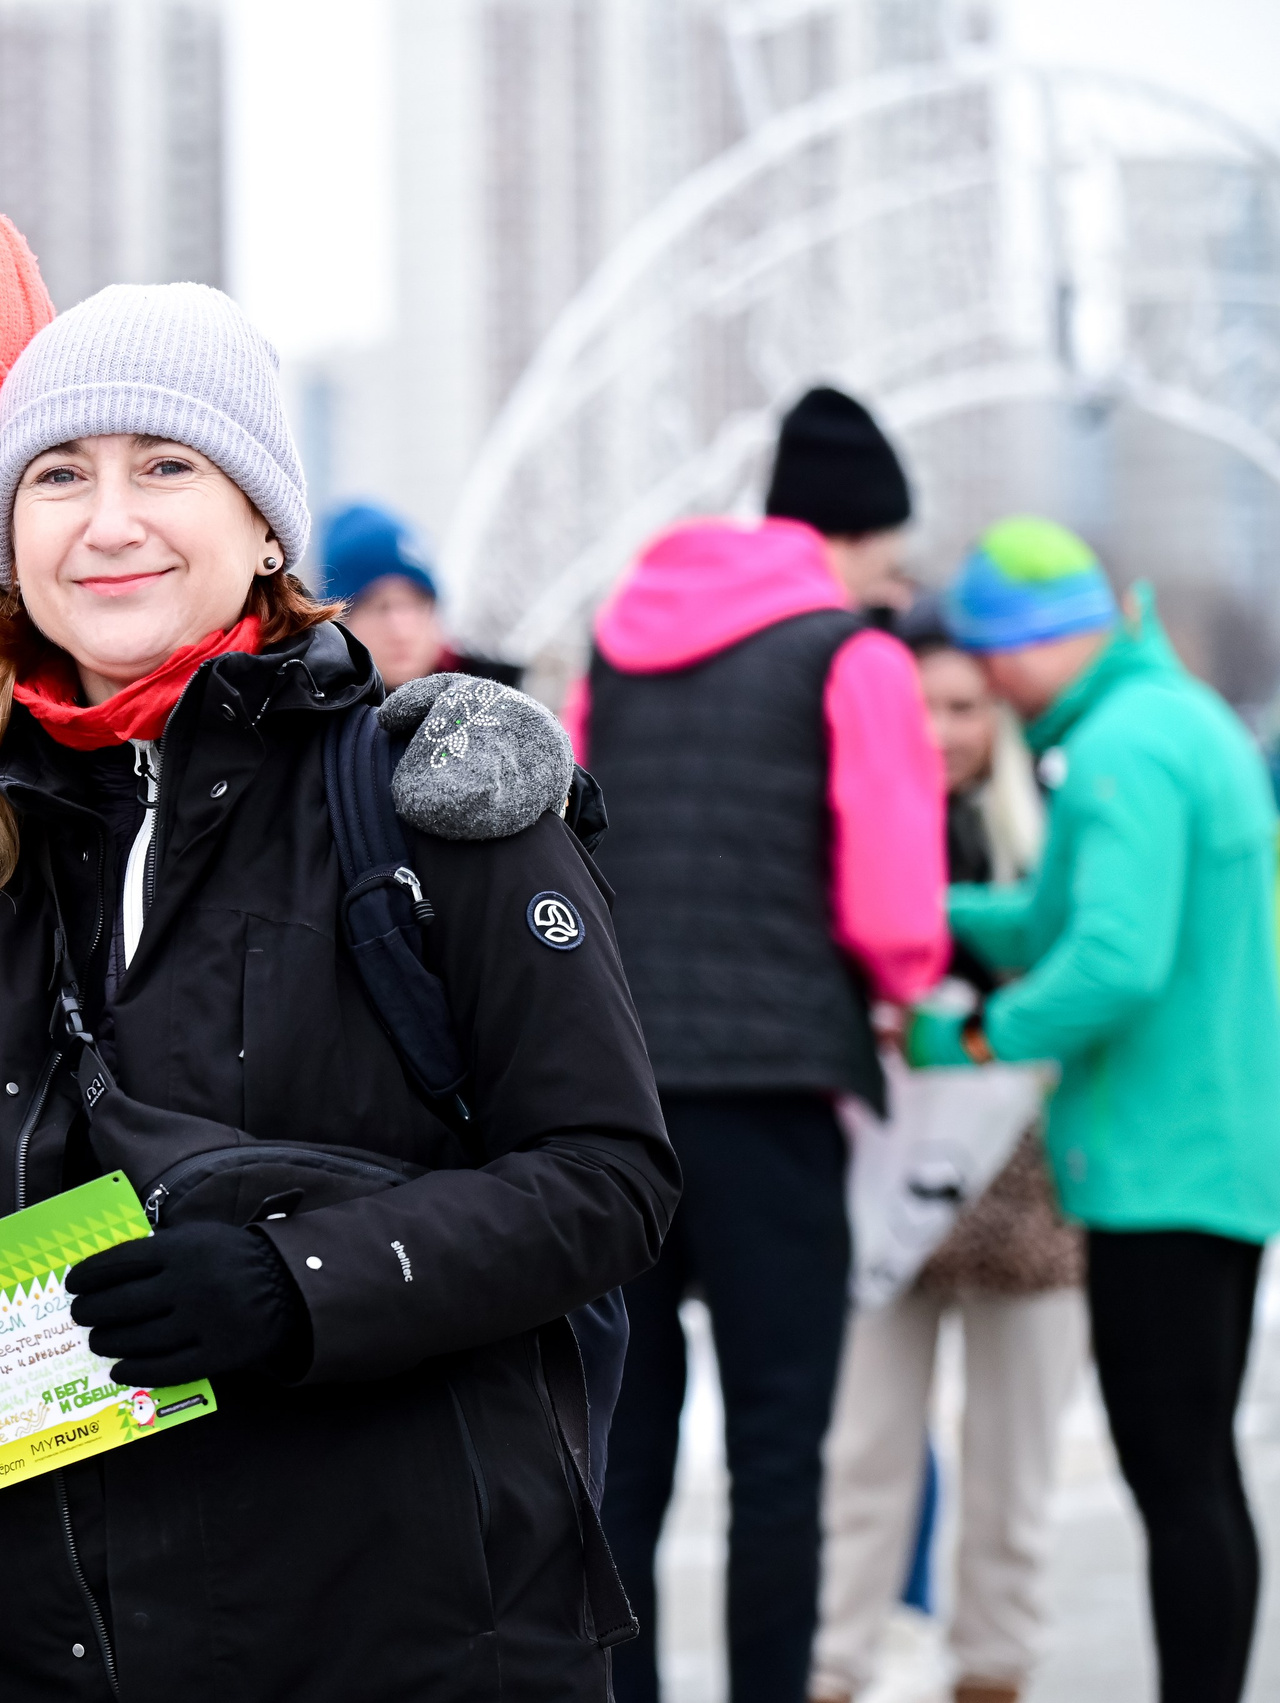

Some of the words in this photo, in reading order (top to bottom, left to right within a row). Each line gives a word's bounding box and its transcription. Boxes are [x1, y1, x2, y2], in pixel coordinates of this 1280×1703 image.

[390, 1240, 413, 1283] shelltec
[41, 1389, 54, 1405] Я
[54, 1376, 89, 1401] БЕГУ
[59, 1400, 72, 1415] И
